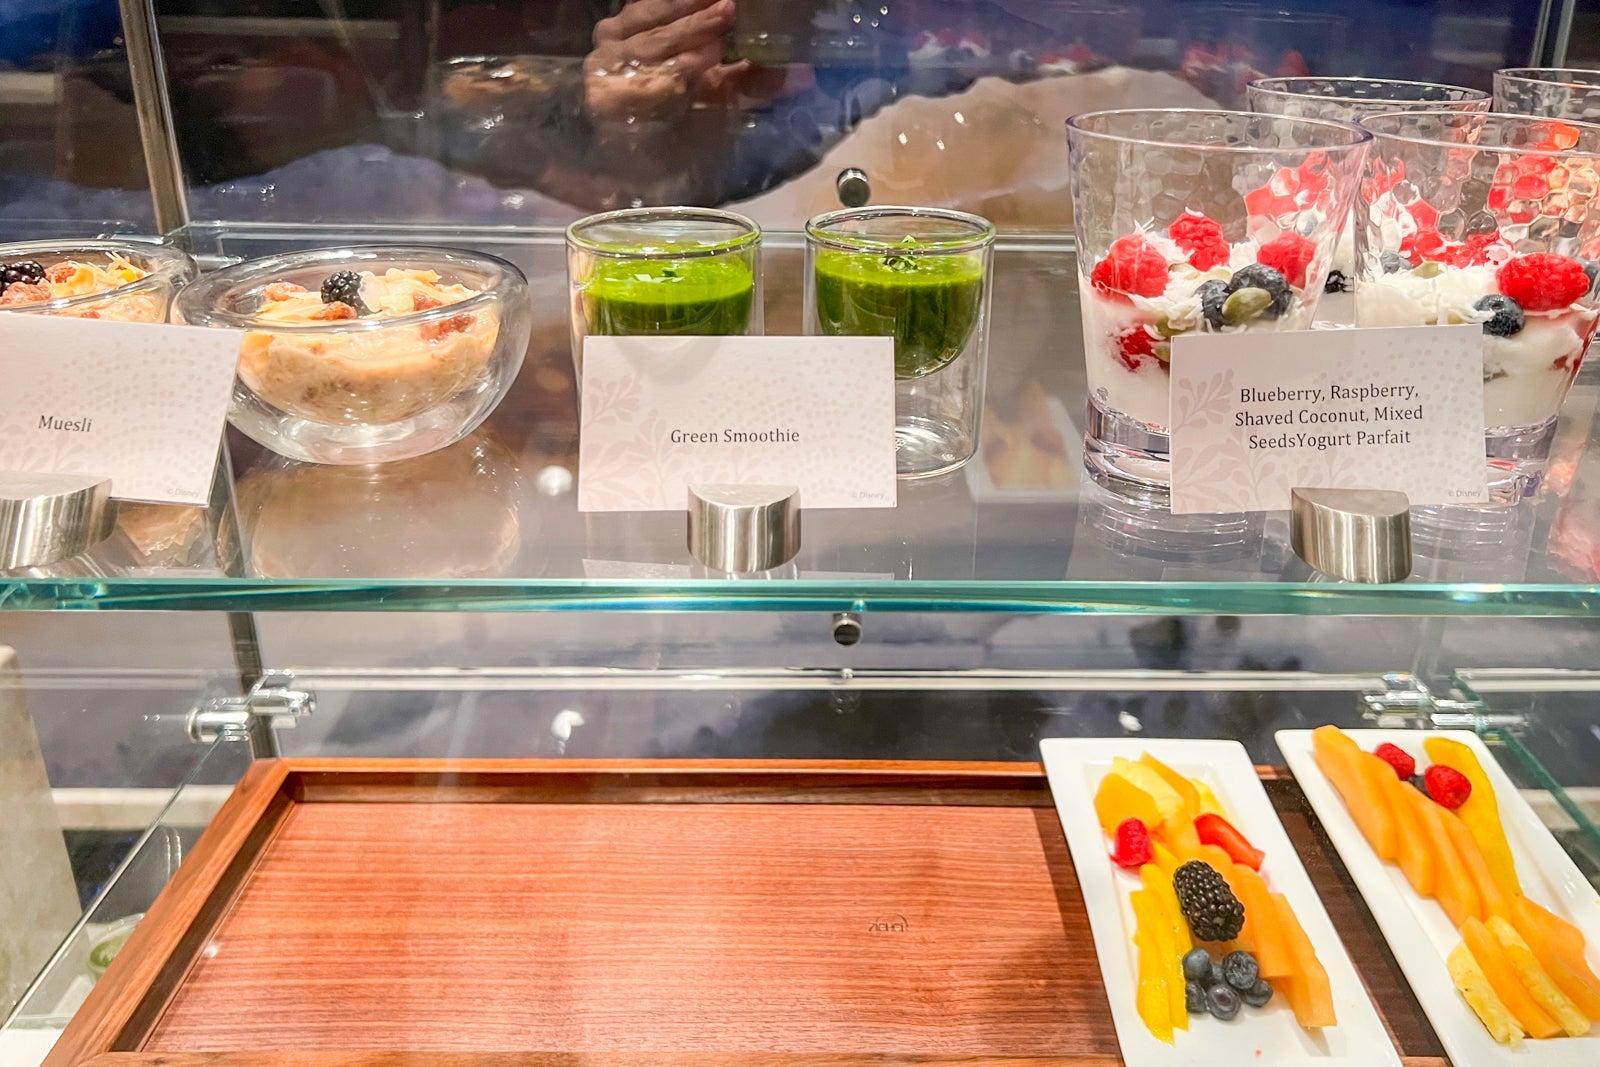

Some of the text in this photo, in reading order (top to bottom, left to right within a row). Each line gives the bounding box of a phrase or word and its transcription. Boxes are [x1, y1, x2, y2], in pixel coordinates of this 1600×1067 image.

[1240, 384, 1419, 403] Blueberry, Raspberry,
[38, 415, 93, 433] Muesli
[1235, 405, 1423, 427] Shaved Coconut, Mixed
[671, 428, 799, 443] Green Smoothie
[1249, 430, 1411, 450] SeedsYogurt Parfait
[175, 488, 200, 498] Disney
[859, 491, 885, 500] Disney
[1456, 489, 1482, 498] Disney
